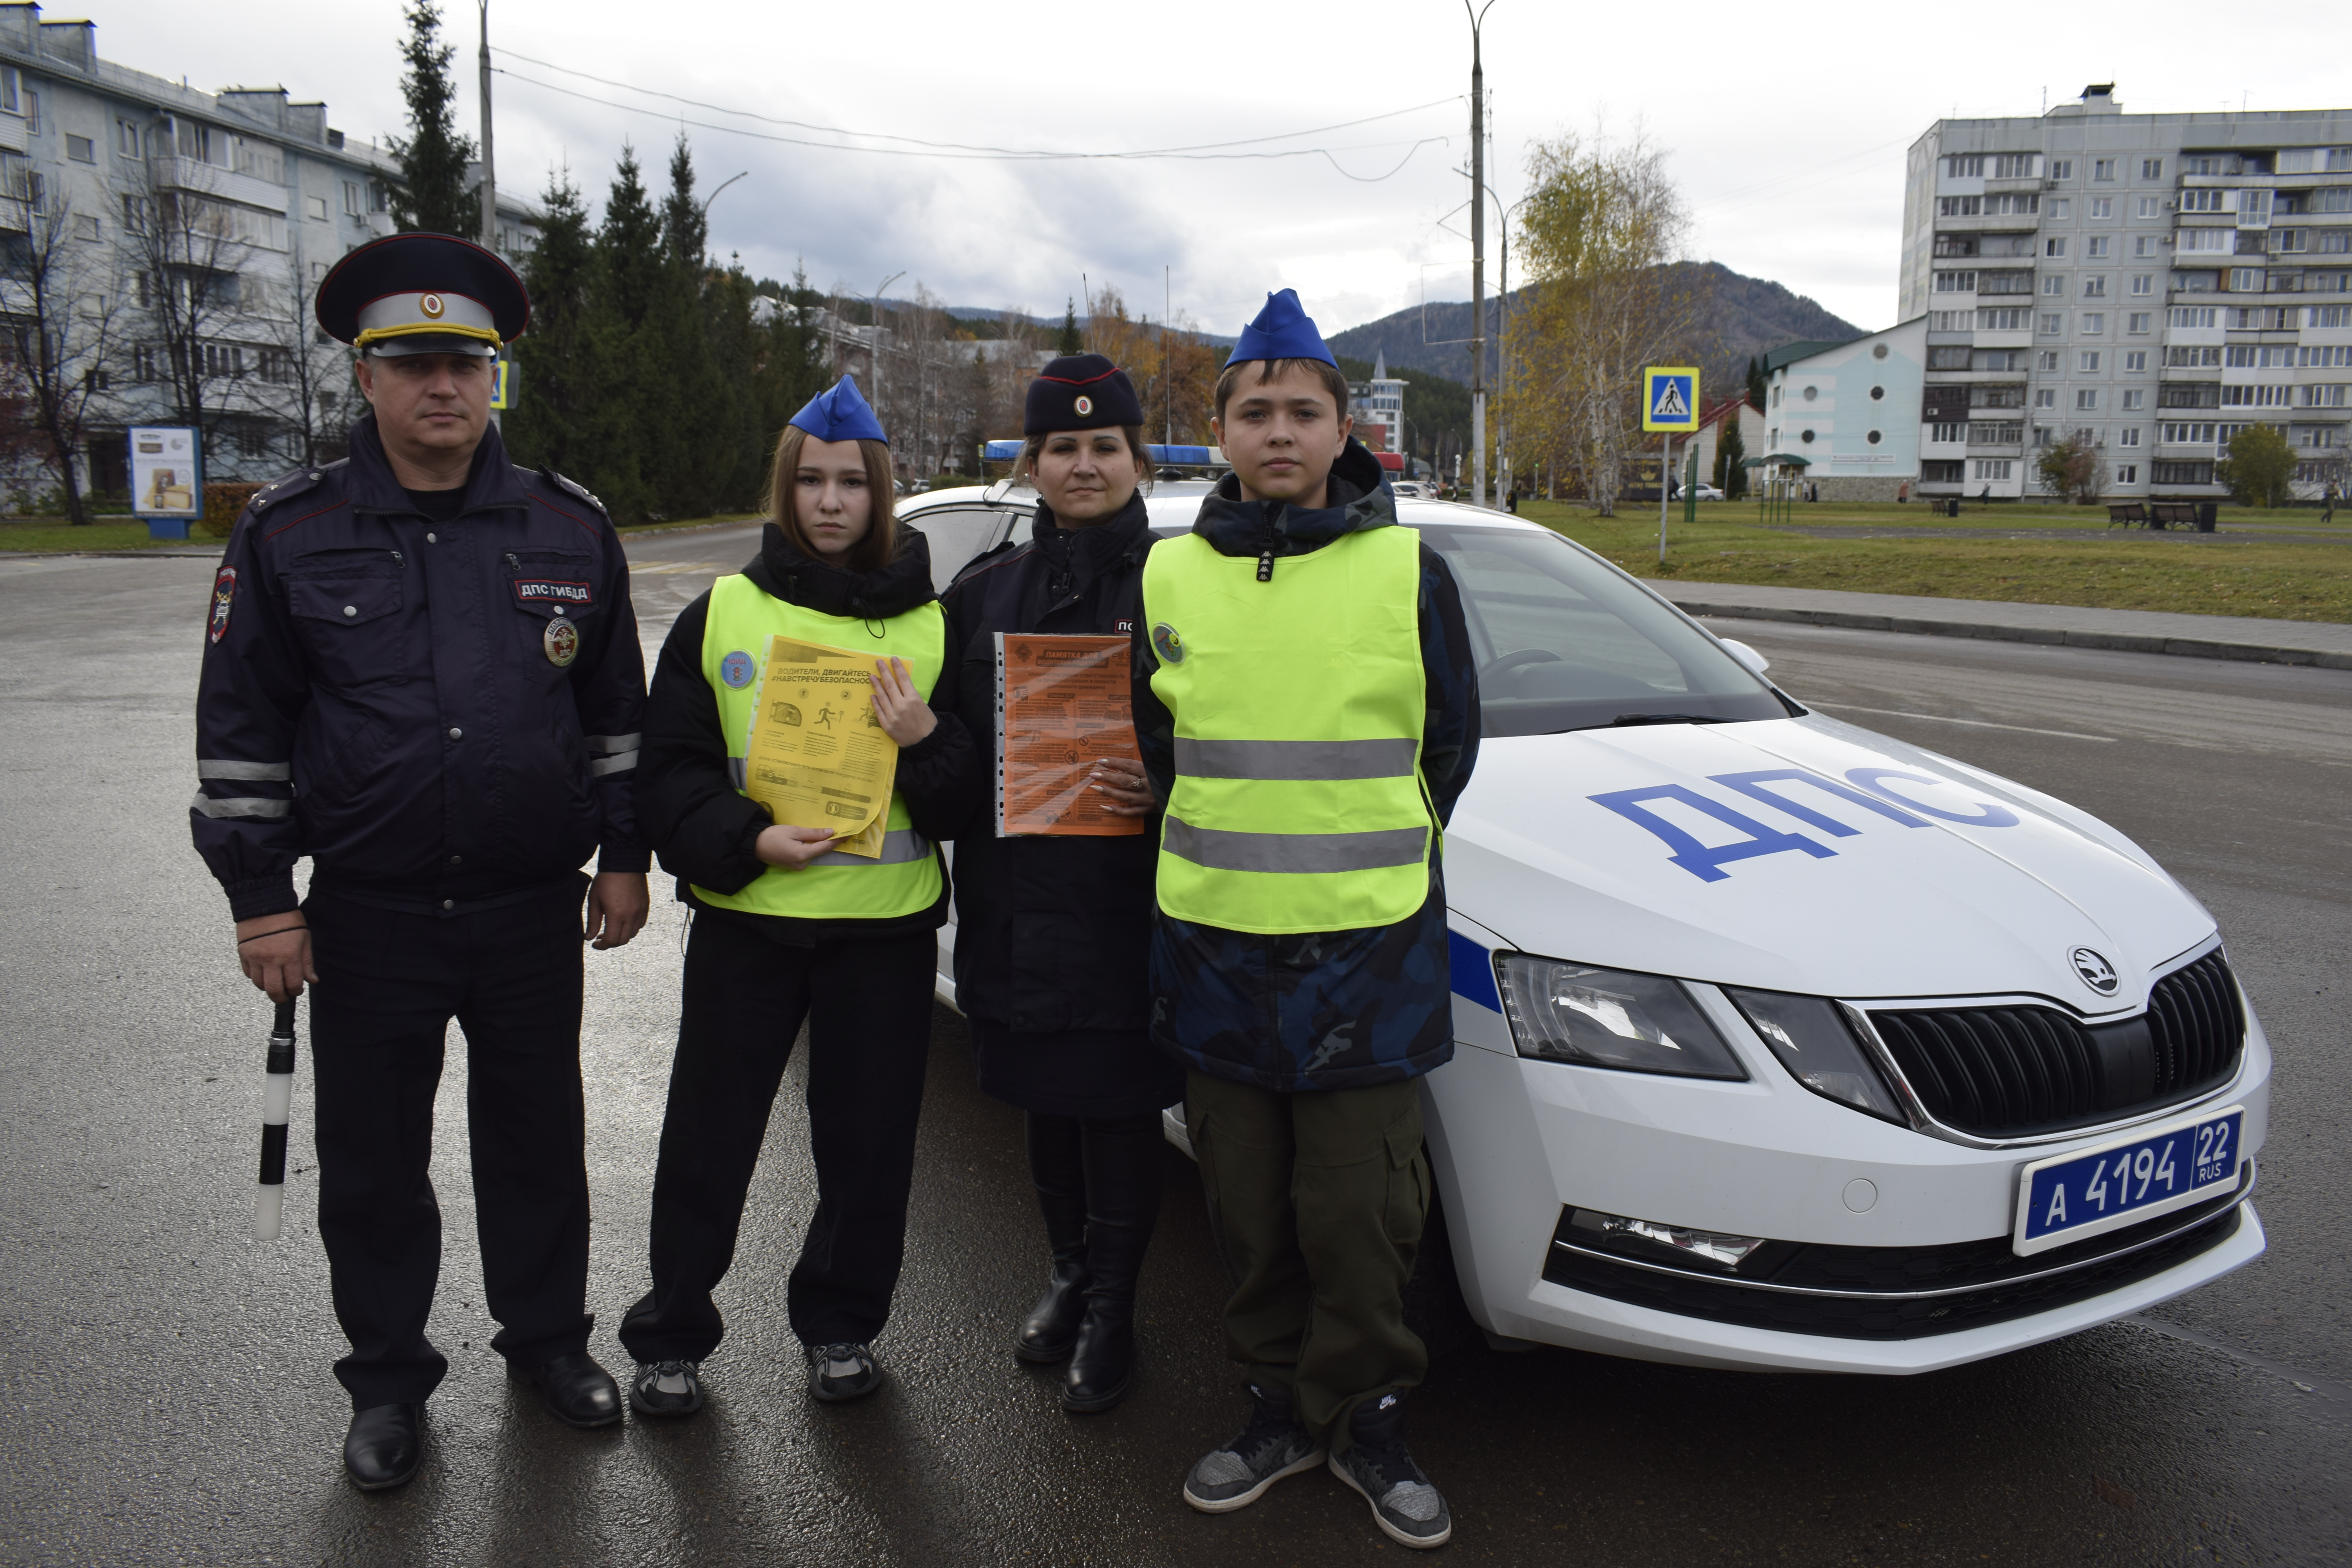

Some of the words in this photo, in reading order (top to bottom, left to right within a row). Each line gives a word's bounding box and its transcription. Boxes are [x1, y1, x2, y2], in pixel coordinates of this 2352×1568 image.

[521, 584, 548, 596] ДПС
[550, 586, 588, 599] ГИБДД
[771, 675, 881, 684] #НАВСТРЕЧУБЕЗОПАСНОС
[822, 668, 871, 677] ДВИГАЙТЕСЬ
[1584, 768, 2020, 883] ДПС
[2045, 1183, 2067, 1227] А
[2085, 1140, 2176, 1211] 4194
[2197, 1122, 2230, 1167] 22
[2199, 1163, 2221, 1183] RUS
[1381, 1395, 1392, 1405] NIKE
